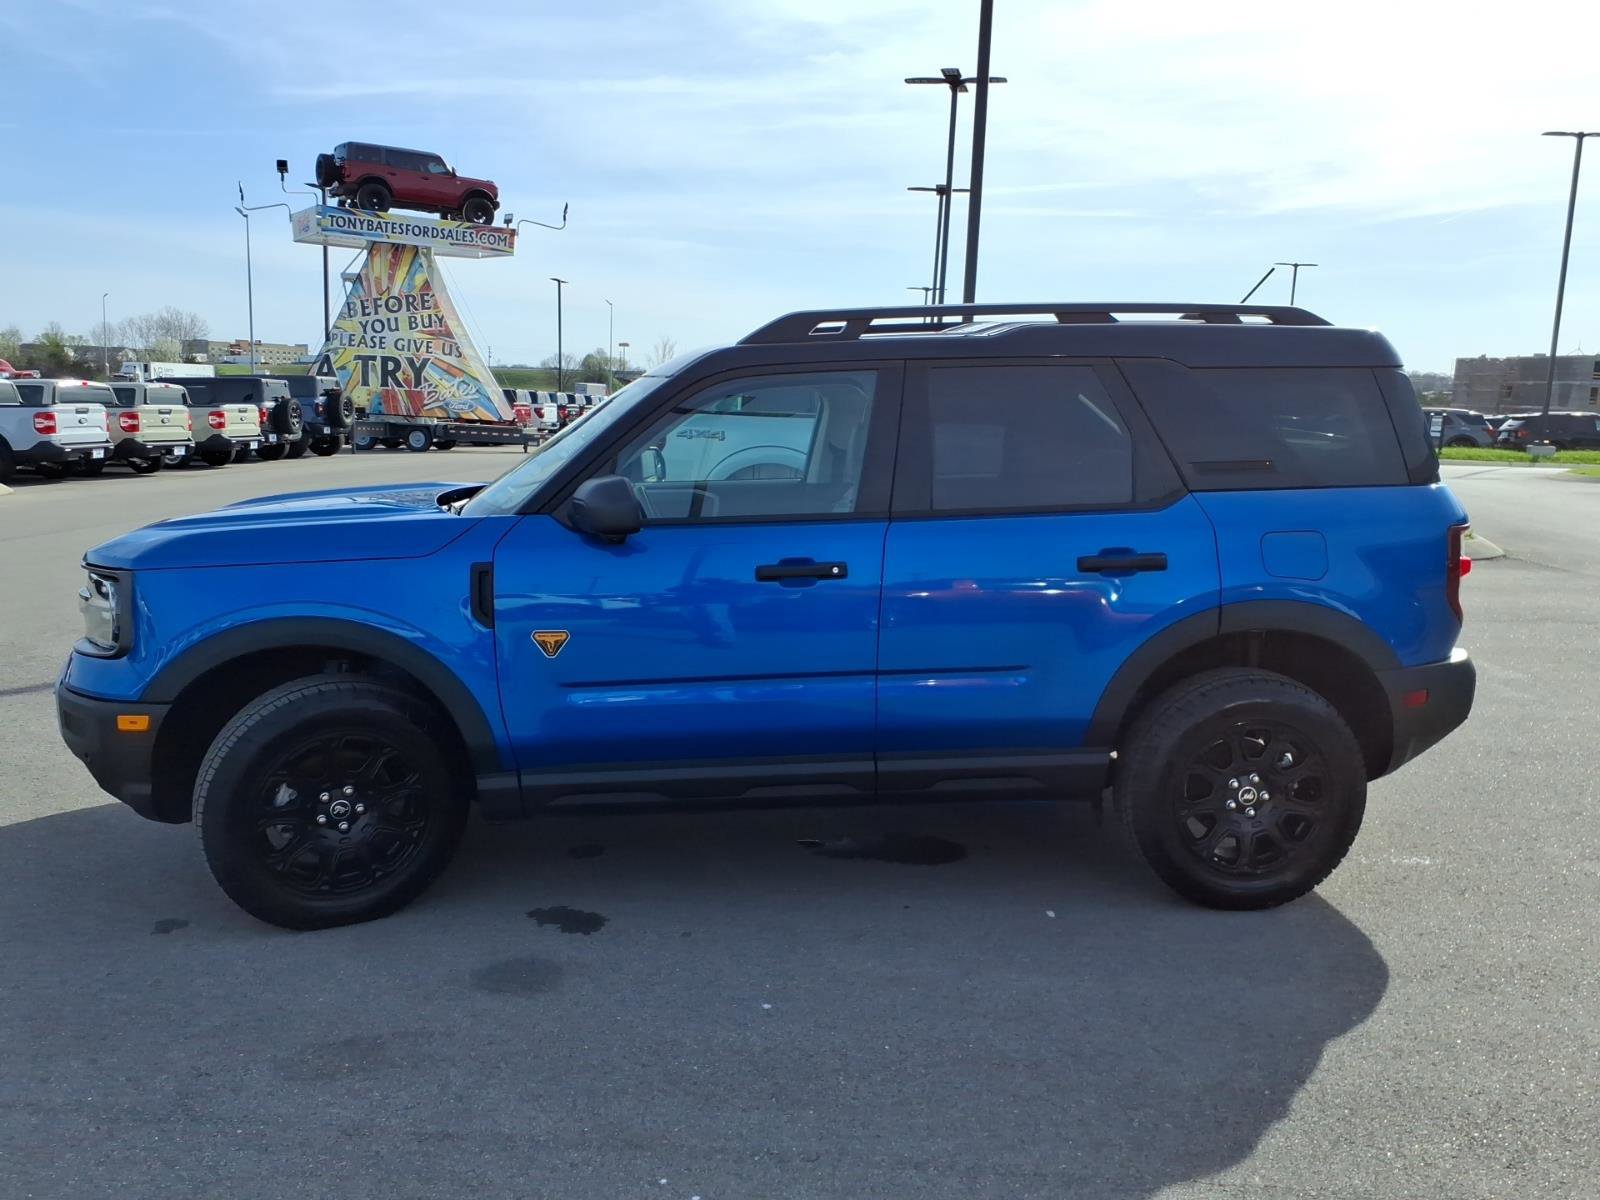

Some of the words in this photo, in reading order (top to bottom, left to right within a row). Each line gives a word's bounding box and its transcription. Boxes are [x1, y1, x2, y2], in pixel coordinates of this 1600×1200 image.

[327, 213, 509, 248] TONYBATESFORDSALES.COM
[347, 292, 432, 319] BEFORE
[358, 316, 400, 335] YOU
[408, 313, 445, 331] BUY
[330, 332, 387, 350] PLEASE
[394, 337, 433, 355] GIVE
[442, 343, 463, 359] US
[315, 353, 337, 377] A
[353, 354, 433, 389] TRY
